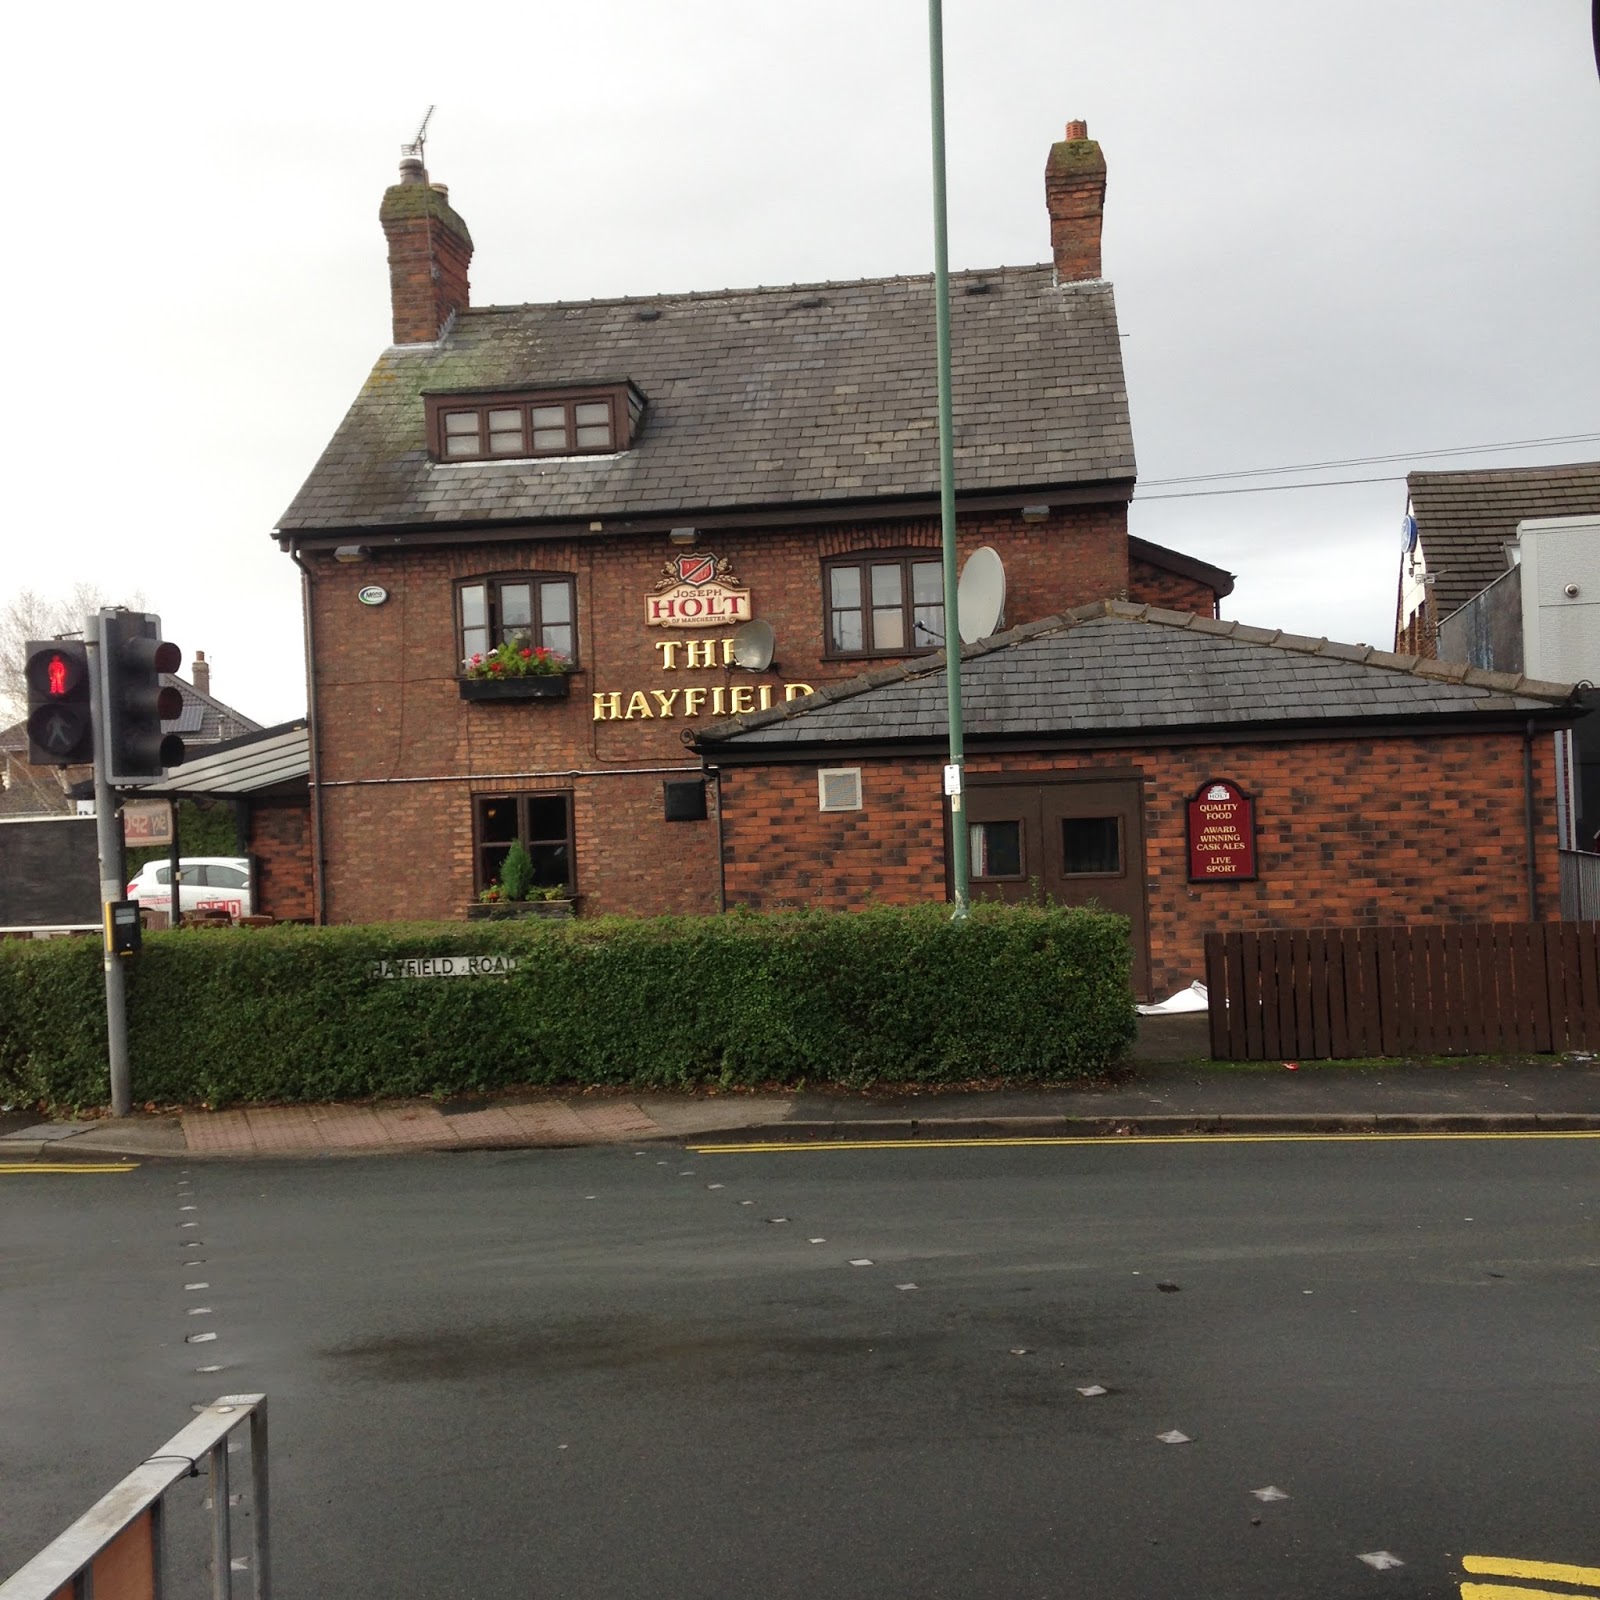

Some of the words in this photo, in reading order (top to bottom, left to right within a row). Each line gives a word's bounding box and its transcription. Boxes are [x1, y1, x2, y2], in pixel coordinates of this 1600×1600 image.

[673, 589, 722, 598] JOSEPH
[652, 596, 745, 618] HOLT
[1200, 804, 1238, 812] QUALITY
[1206, 812, 1232, 820] FOOD
[1203, 826, 1236, 834] AWARD
[1200, 834, 1240, 842] WINNING
[1211, 856, 1231, 864] LIVE
